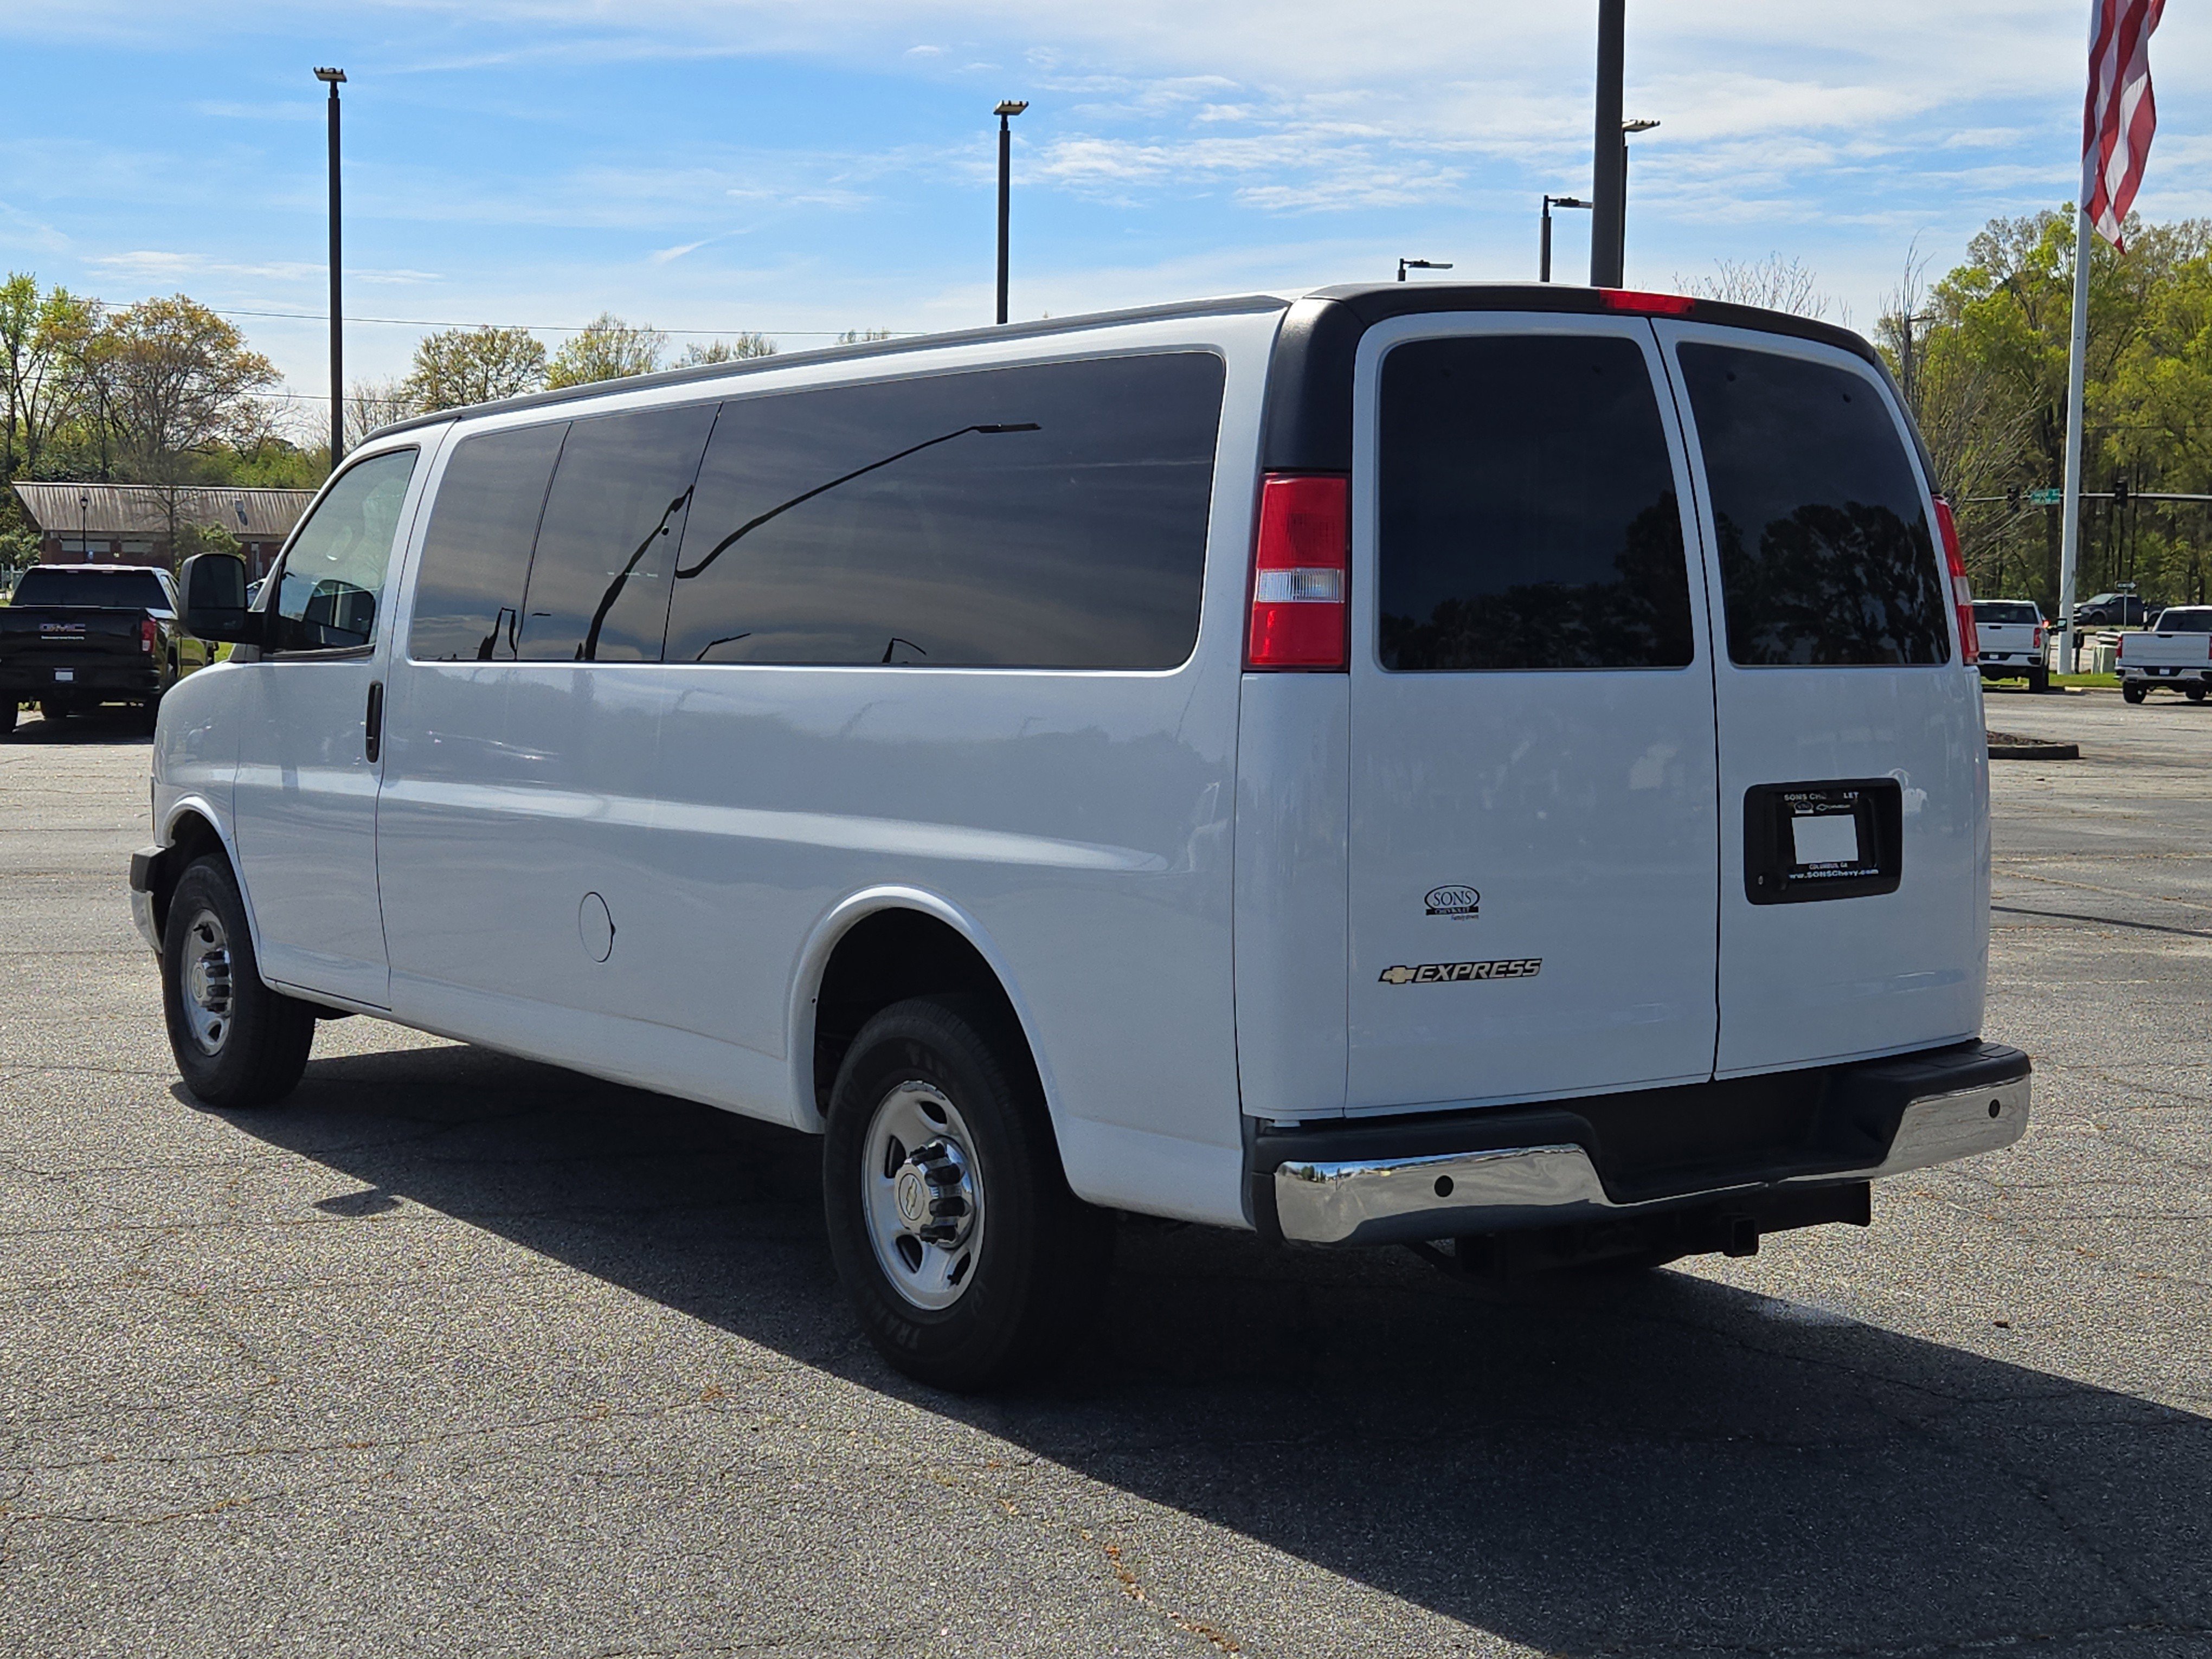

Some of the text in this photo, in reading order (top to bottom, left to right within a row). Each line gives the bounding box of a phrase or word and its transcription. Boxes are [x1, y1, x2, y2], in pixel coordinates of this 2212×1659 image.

[39, 623, 86, 632] GMC
[1433, 890, 1471, 906] SONS
[1414, 959, 1542, 983] EXPRESS
